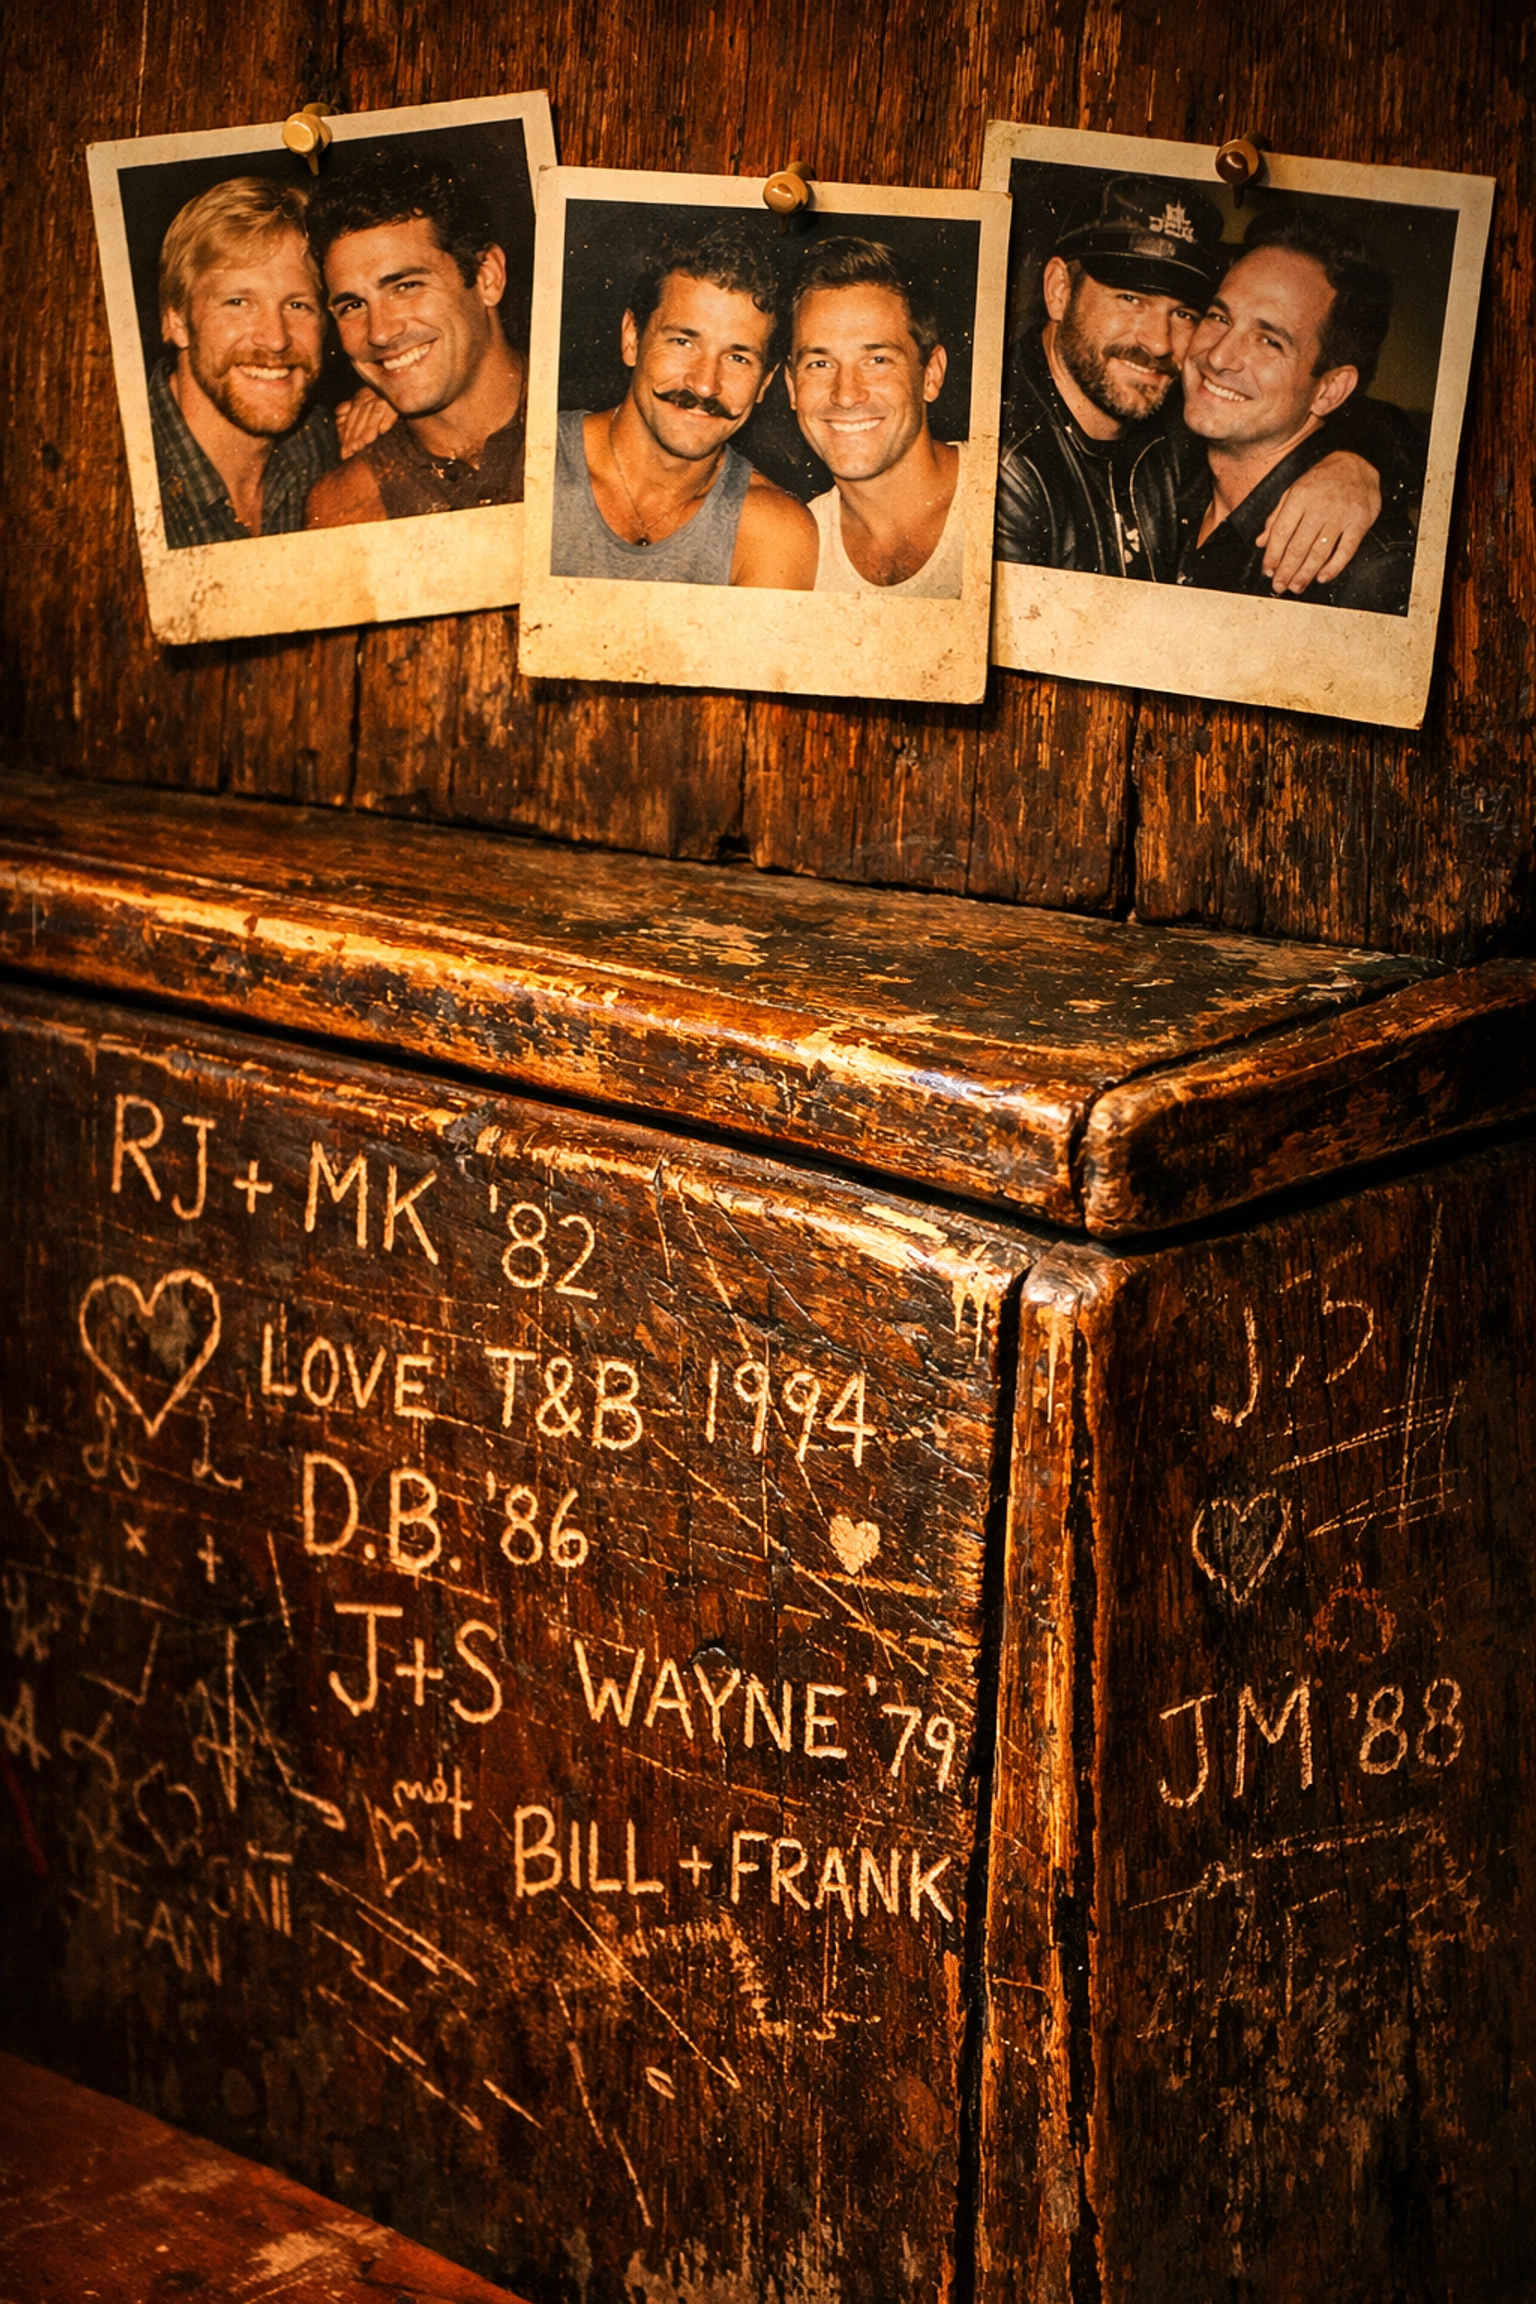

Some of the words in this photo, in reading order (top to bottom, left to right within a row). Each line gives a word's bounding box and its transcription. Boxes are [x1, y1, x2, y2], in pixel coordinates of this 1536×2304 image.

[111, 1094, 216, 1219] RJ
[304, 1141, 439, 1264] MK
[490, 1184, 598, 1299] '82
[261, 1322, 436, 1418] LOVE
[485, 1346, 644, 1449] T&B
[706, 1356, 876, 1468] 1994
[302, 1453, 462, 1572] D.B.
[487, 1471, 589, 1567] '86
[573, 1638, 848, 1760] WAYNE
[868, 1674, 957, 1790] '79
[1158, 1674, 1314, 1809] JM
[1347, 1677, 1465, 1776] '88
[514, 1805, 664, 1897] BILL
[731, 1830, 954, 1923] FRANK
